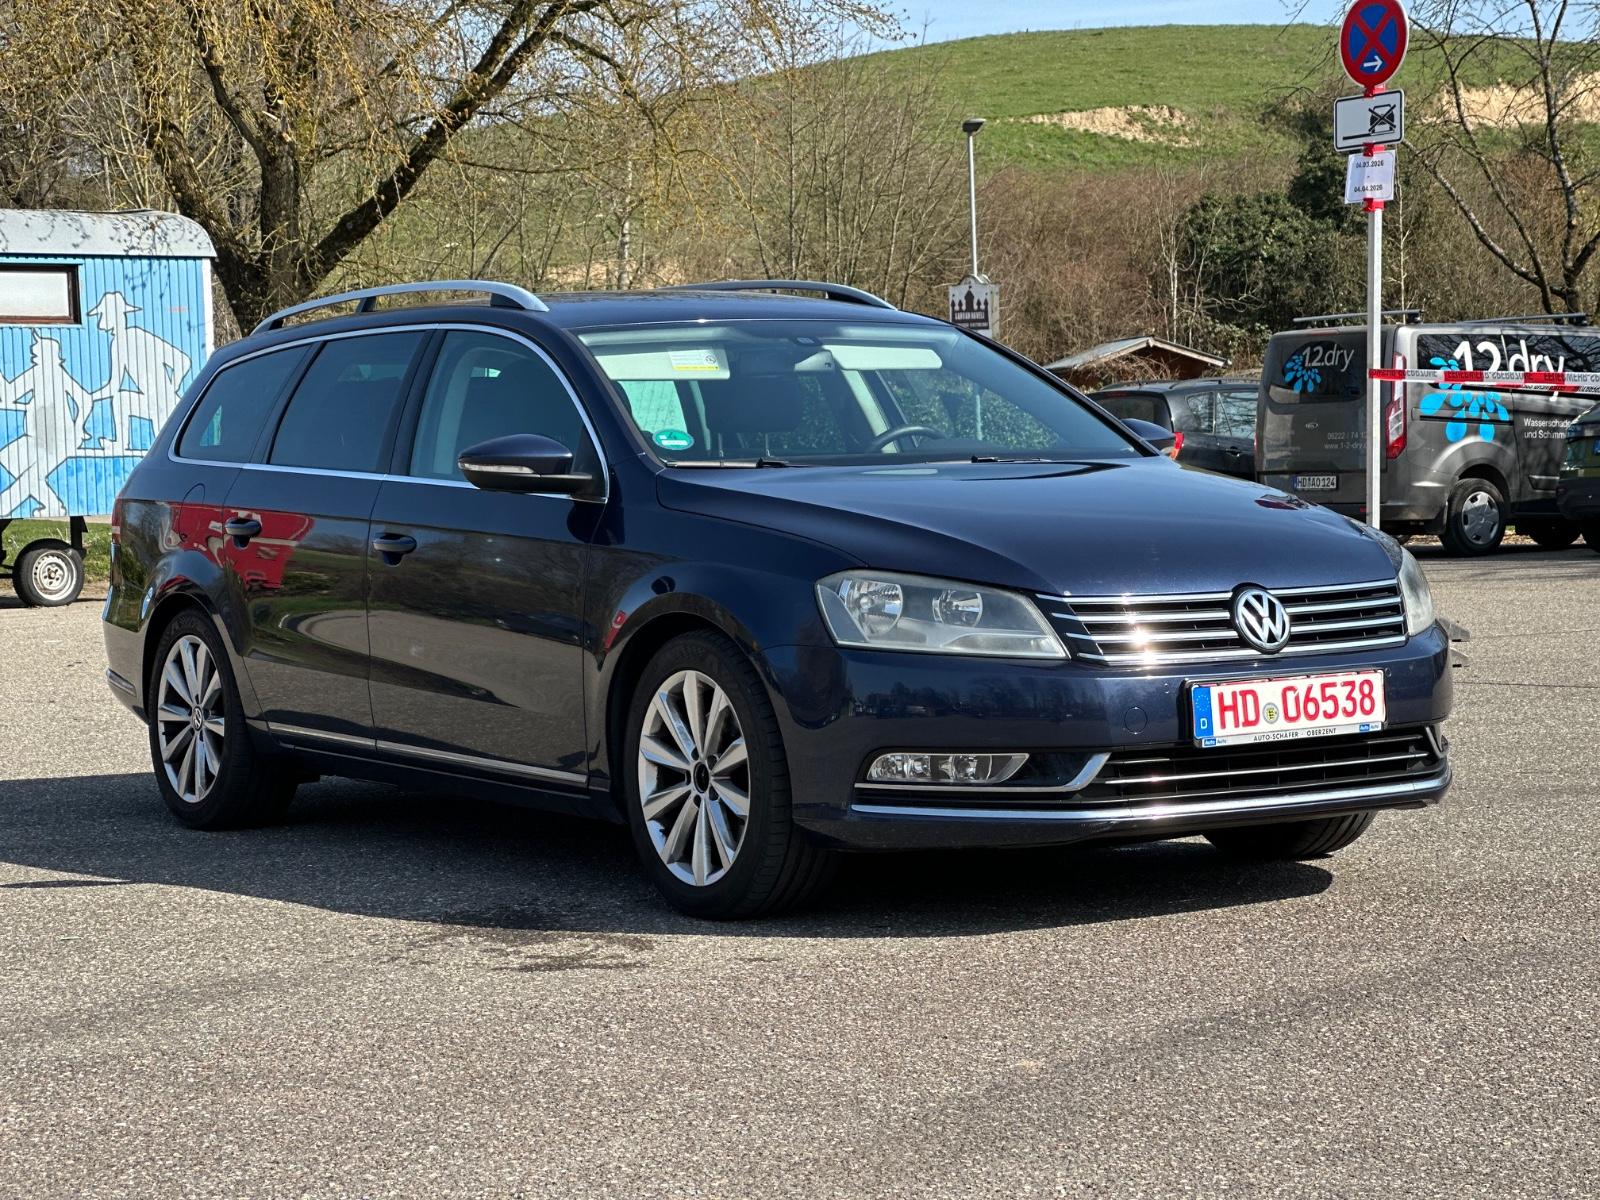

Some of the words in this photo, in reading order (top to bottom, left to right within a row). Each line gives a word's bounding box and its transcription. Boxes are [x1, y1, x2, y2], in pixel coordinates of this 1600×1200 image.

[1524, 430, 1537, 439] und
[1218, 689, 1260, 730] HD
[1281, 679, 1376, 723] 06538
[1306, 728, 1337, 738] OBERZENT
